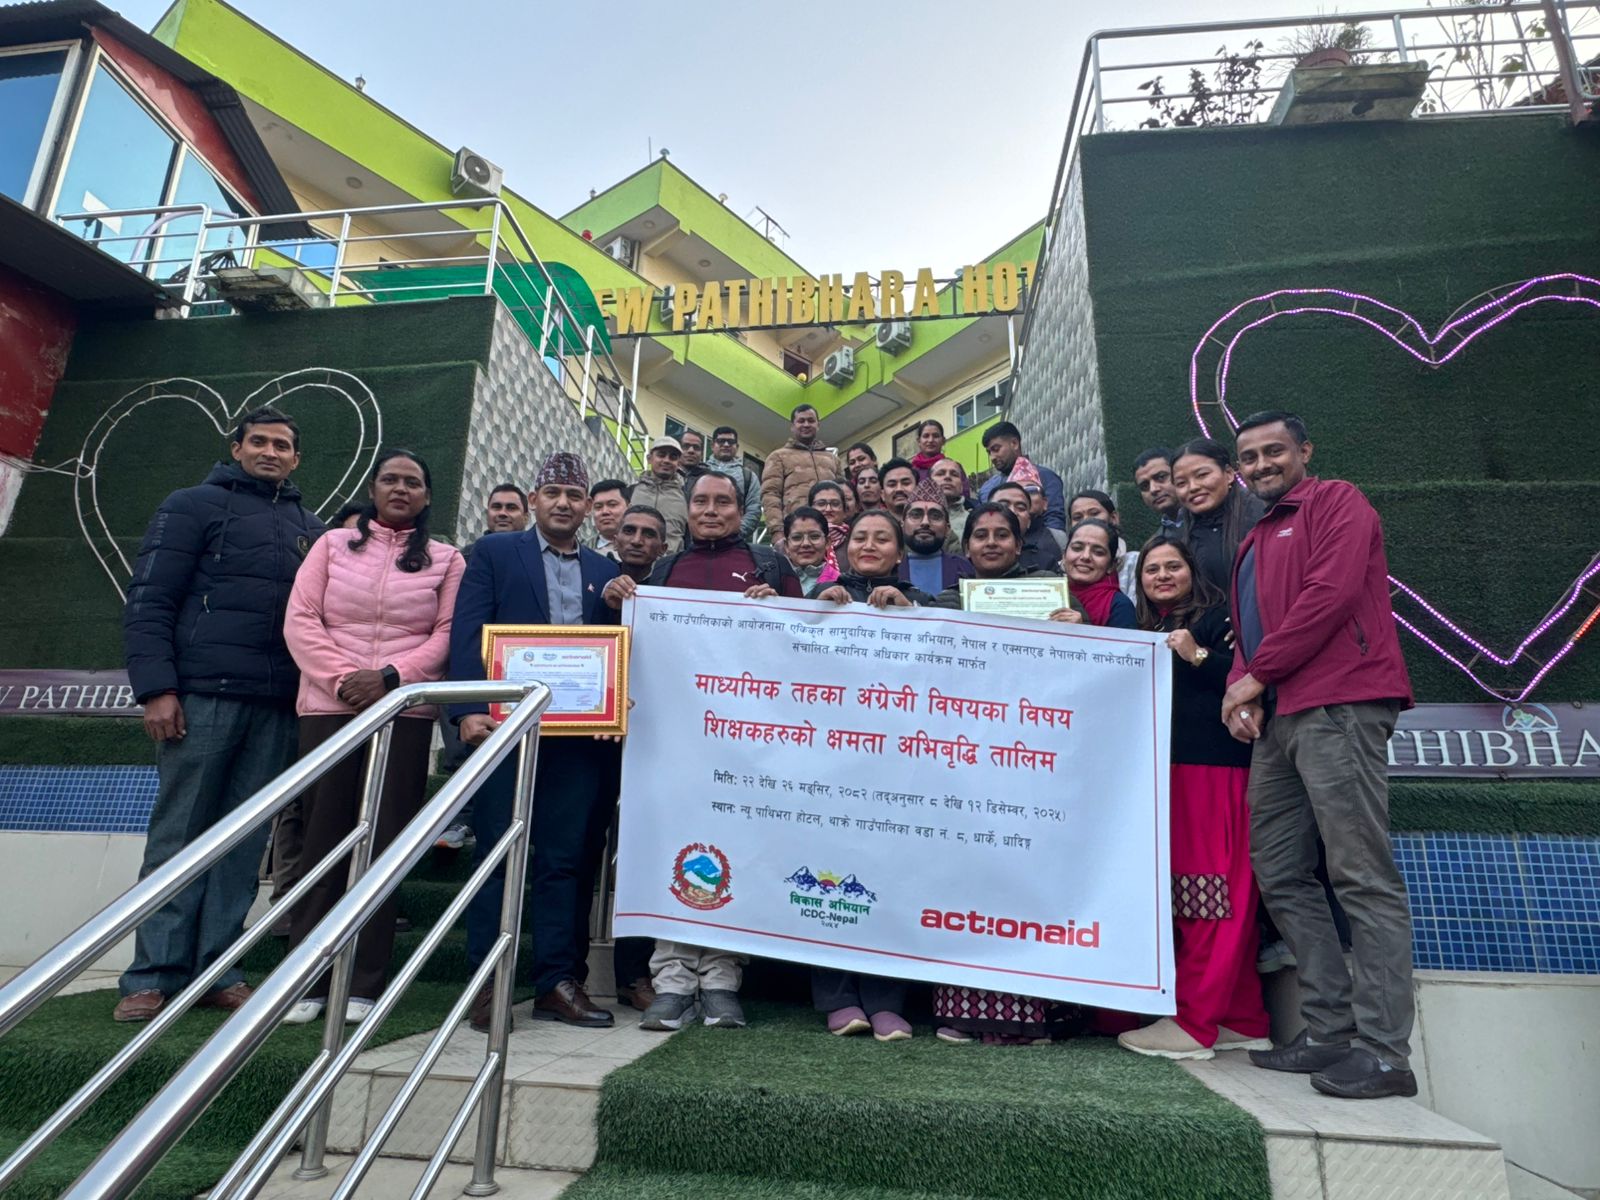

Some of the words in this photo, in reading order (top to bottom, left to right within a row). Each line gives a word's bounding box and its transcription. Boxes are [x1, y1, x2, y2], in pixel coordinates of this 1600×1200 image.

[672, 267, 940, 331] PATHIBHARA
[961, 637, 987, 651] नेपाल
[992, 642, 998, 651] र
[17, 685, 145, 709] PATHIB
[695, 671, 782, 700] माध्यमिक
[791, 682, 847, 706] तहका
[857, 682, 918, 713] अंग्रेजी
[928, 687, 1009, 723] विषयका
[1019, 697, 1074, 730] विषय
[704, 710, 817, 748] शिक्षकहरुको
[826, 728, 887, 755] क्षमता
[989, 740, 1057, 773] तालिम
[742, 775, 754, 788] २२
[759, 775, 777, 790] देखि
[838, 786, 868, 801] २०८२
[944, 795, 964, 810] देखि
[967, 800, 982, 813] १२
[789, 891, 824, 908] विकास
[829, 898, 871, 916] अभियान
[800, 907, 858, 925] ICDC-Nepal
